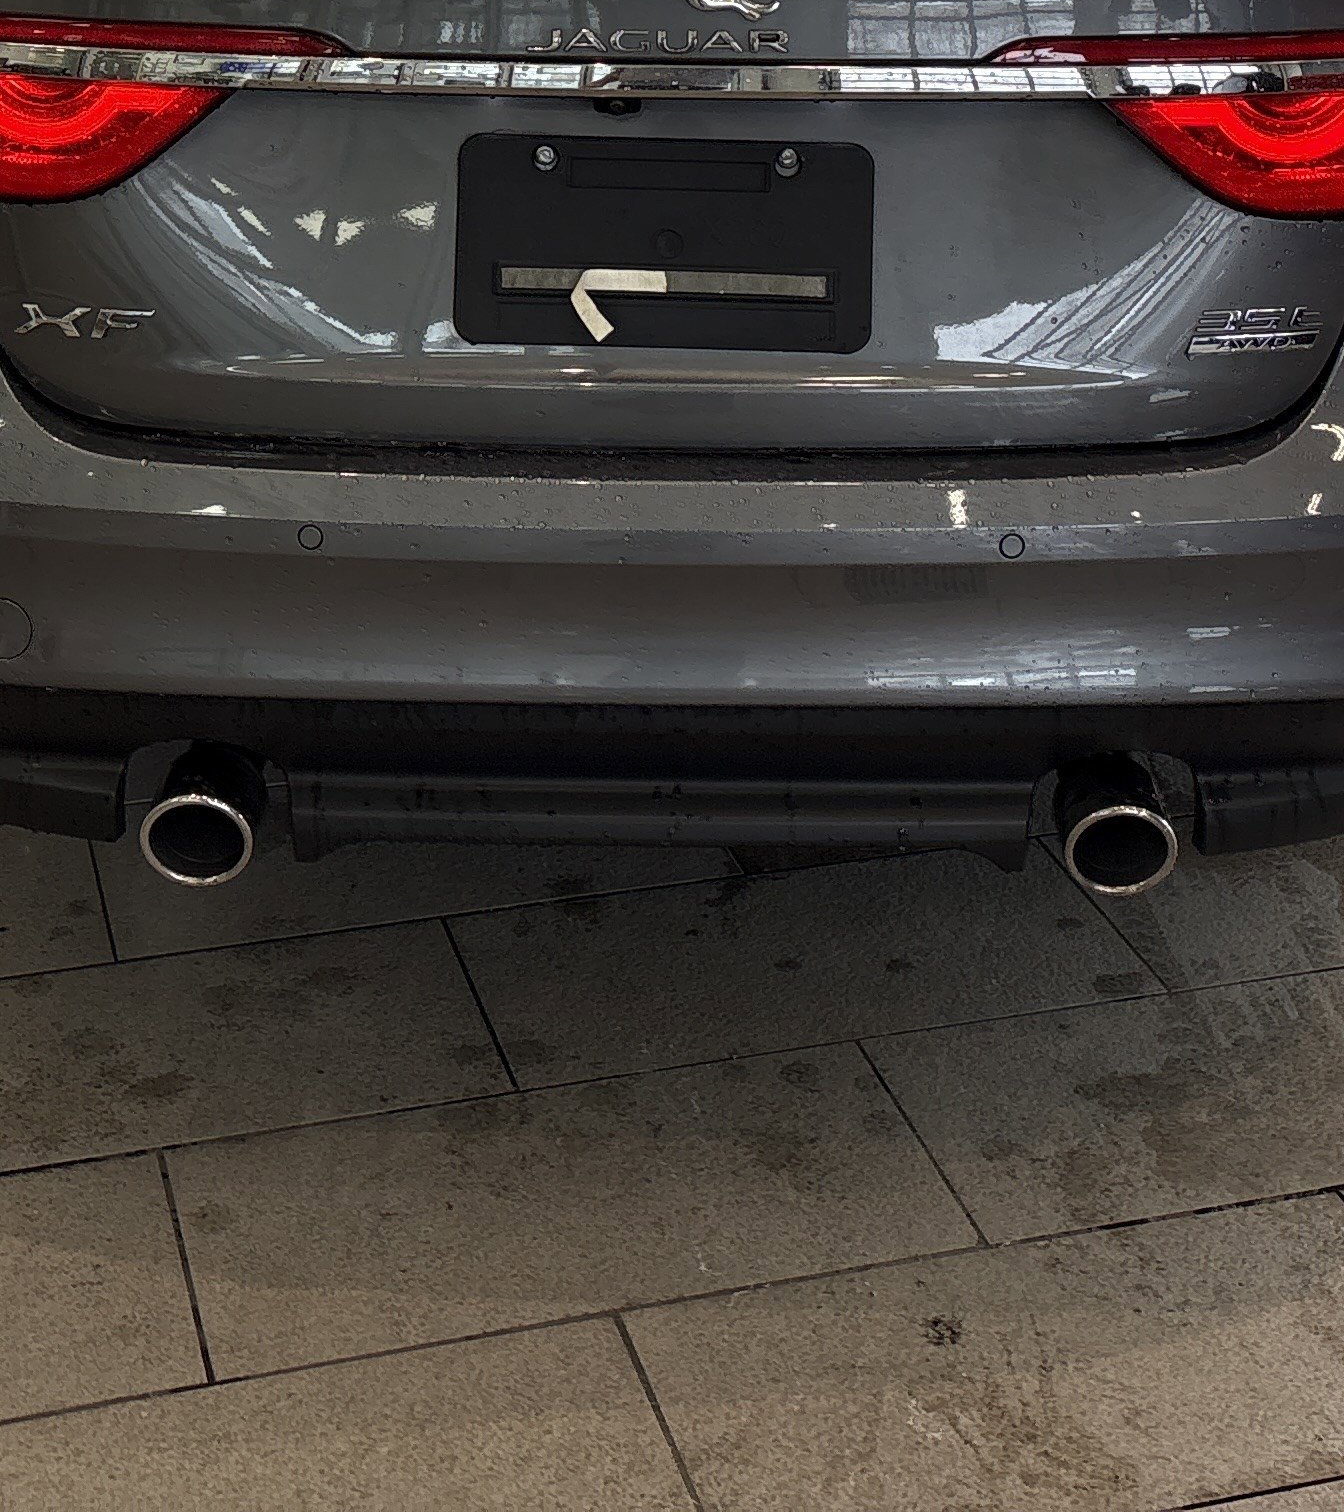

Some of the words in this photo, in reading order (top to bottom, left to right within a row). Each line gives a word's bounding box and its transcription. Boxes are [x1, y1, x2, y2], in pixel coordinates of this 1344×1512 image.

[526, 28, 790, 54] JAGUAR
[14, 303, 156, 339] XF
[1216, 336, 1295, 352] AWD
